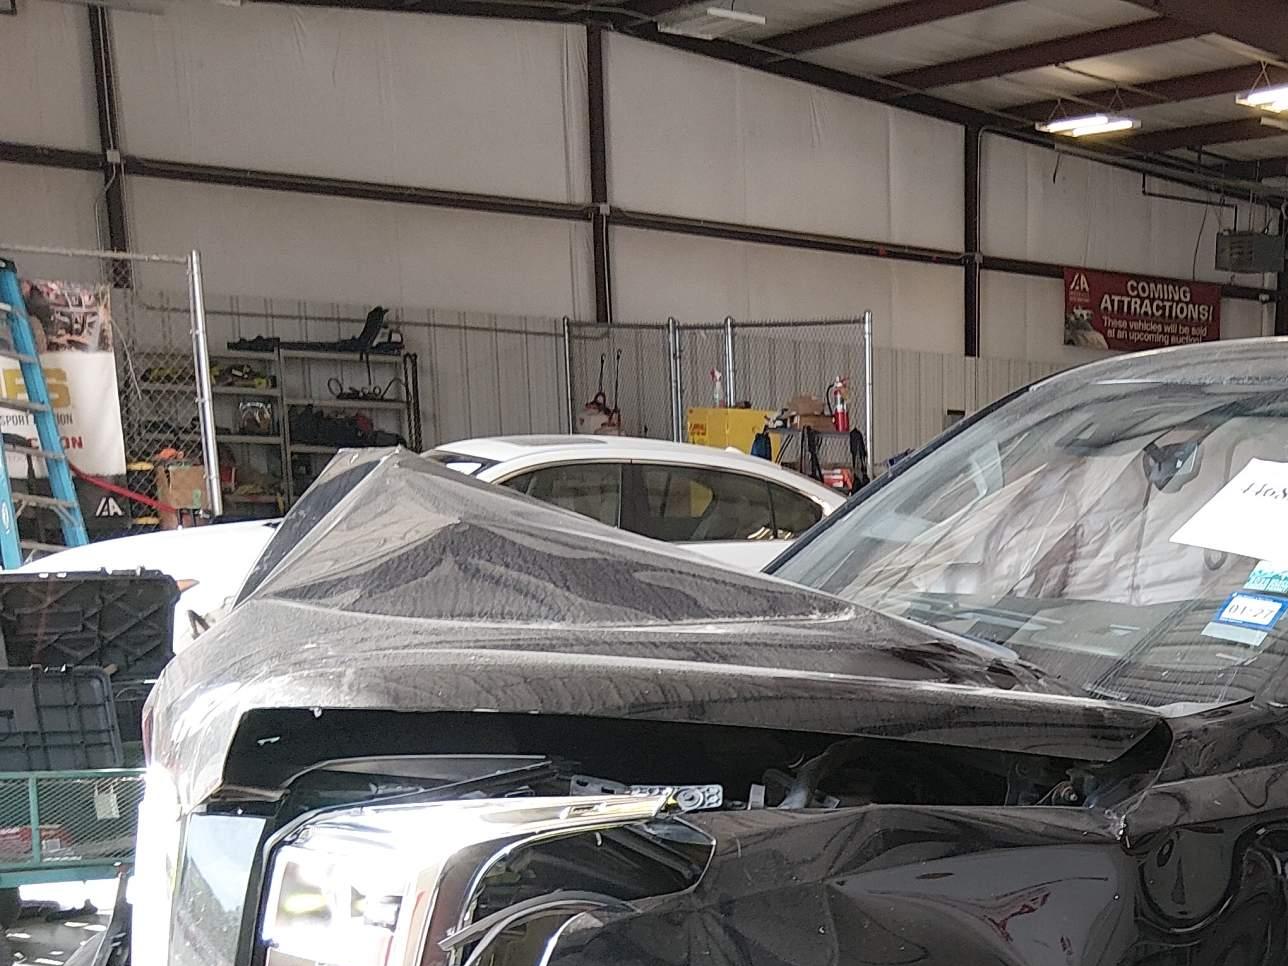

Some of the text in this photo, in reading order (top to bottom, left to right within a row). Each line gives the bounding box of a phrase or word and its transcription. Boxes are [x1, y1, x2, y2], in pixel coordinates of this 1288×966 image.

[1127, 280, 1191, 302] COMING
[1100, 294, 1213, 321] ATTRACTIONS!
[1103, 316, 1208, 337] These vehicles will be sold
[1107, 328, 1115, 338] at
[1117, 329, 1128, 340] an
[1129, 330, 1169, 345] upcoming
